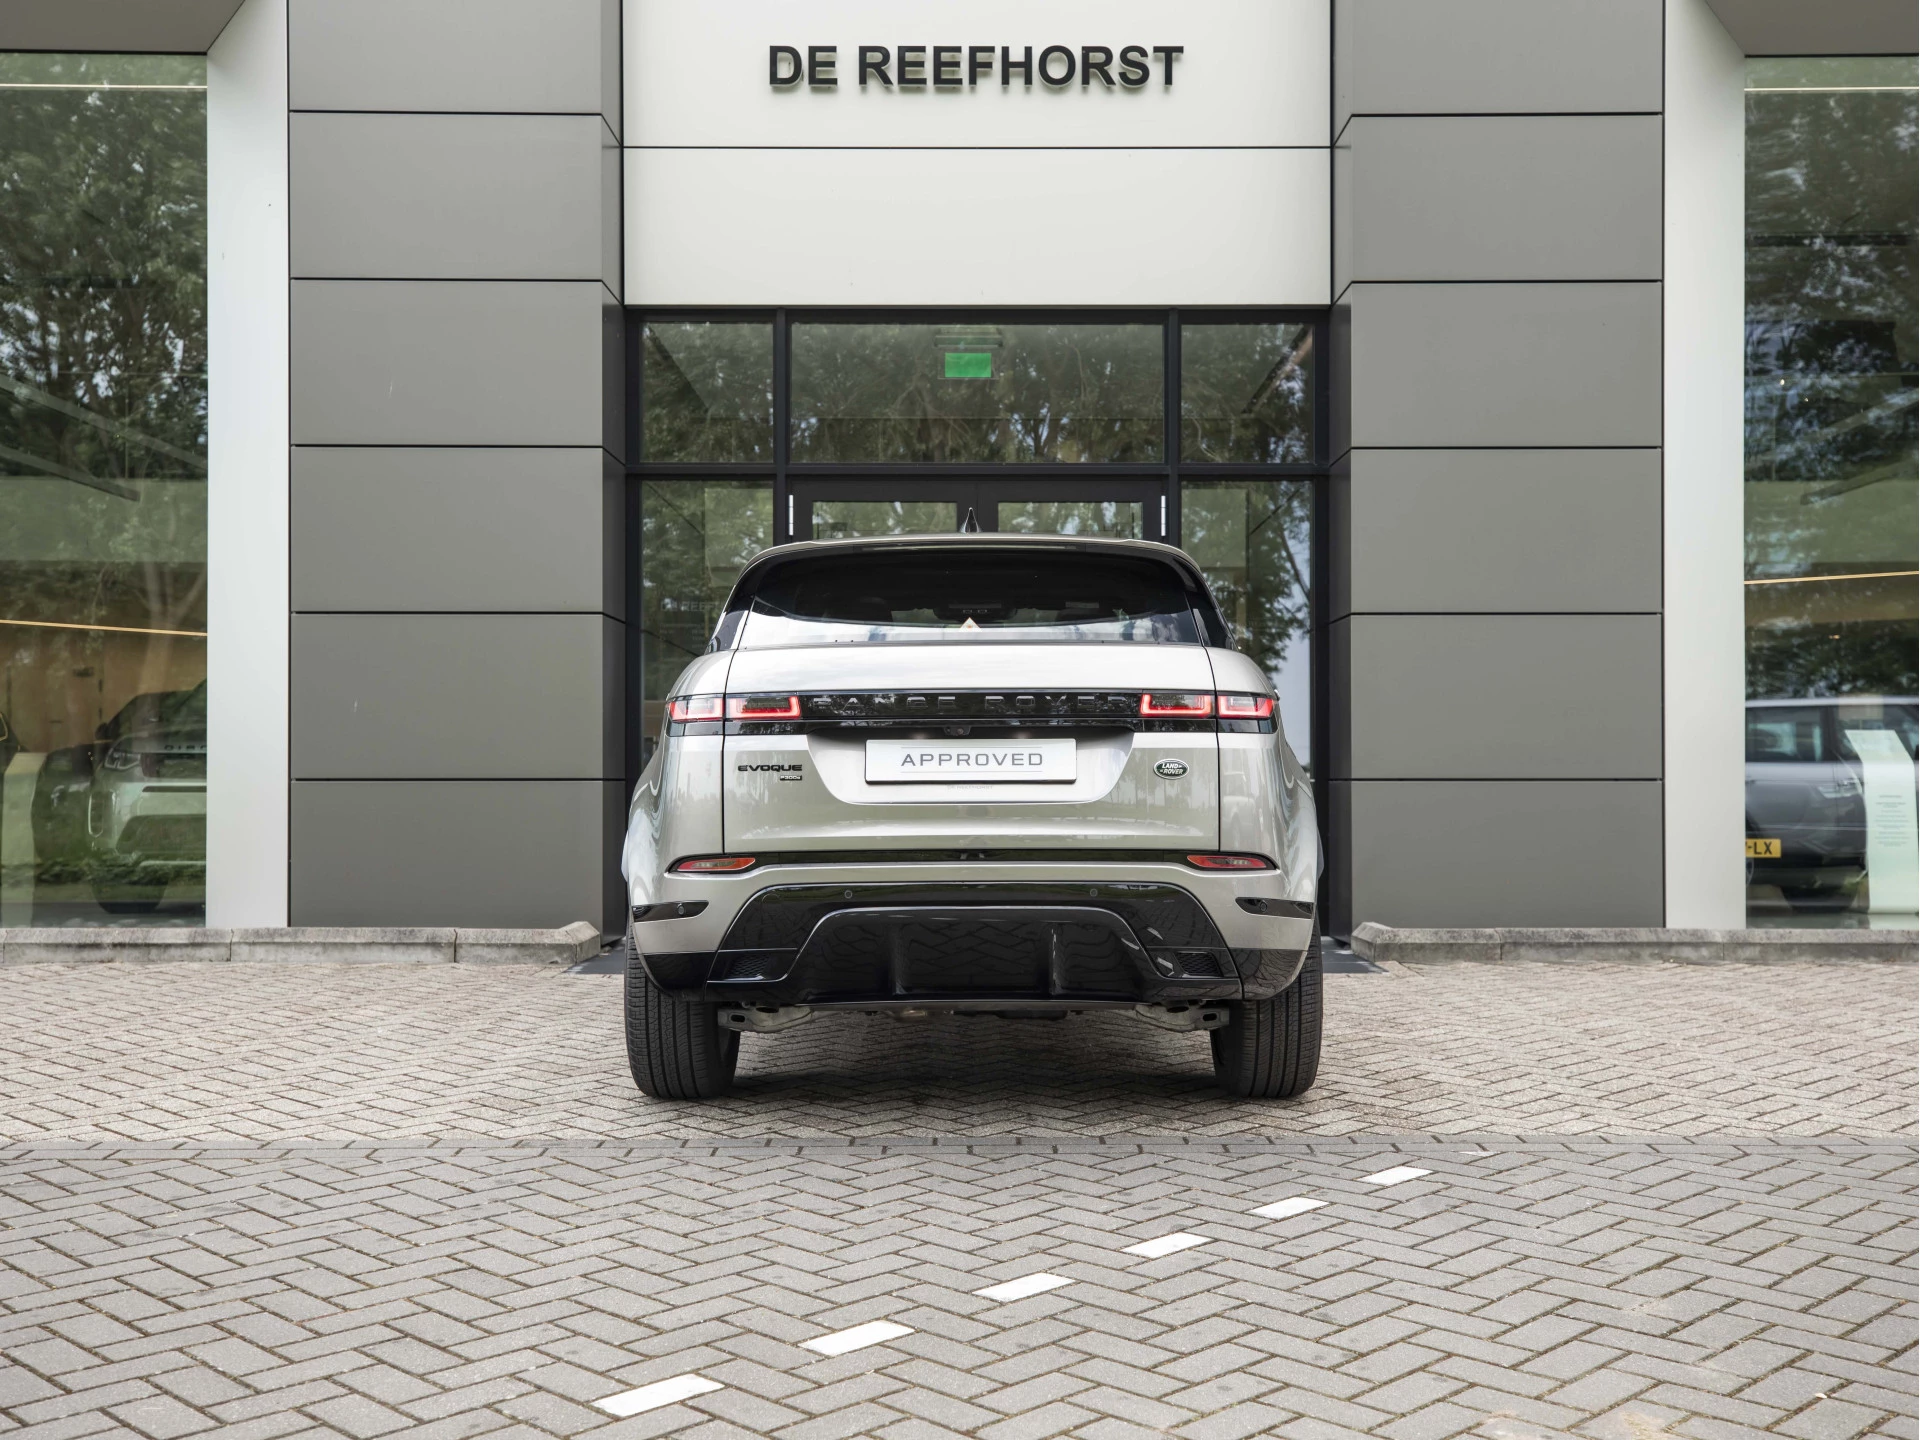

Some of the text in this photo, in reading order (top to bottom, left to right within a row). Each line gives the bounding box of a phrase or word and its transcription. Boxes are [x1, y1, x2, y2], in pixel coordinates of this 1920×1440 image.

[769, 45, 1184, 87] DE REEFHORST
[984, 695, 1129, 711] ROVER
[900, 753, 1043, 767] APPROVED
[737, 764, 803, 772] EVOQUE
[1745, 841, 1773, 855] -LX
